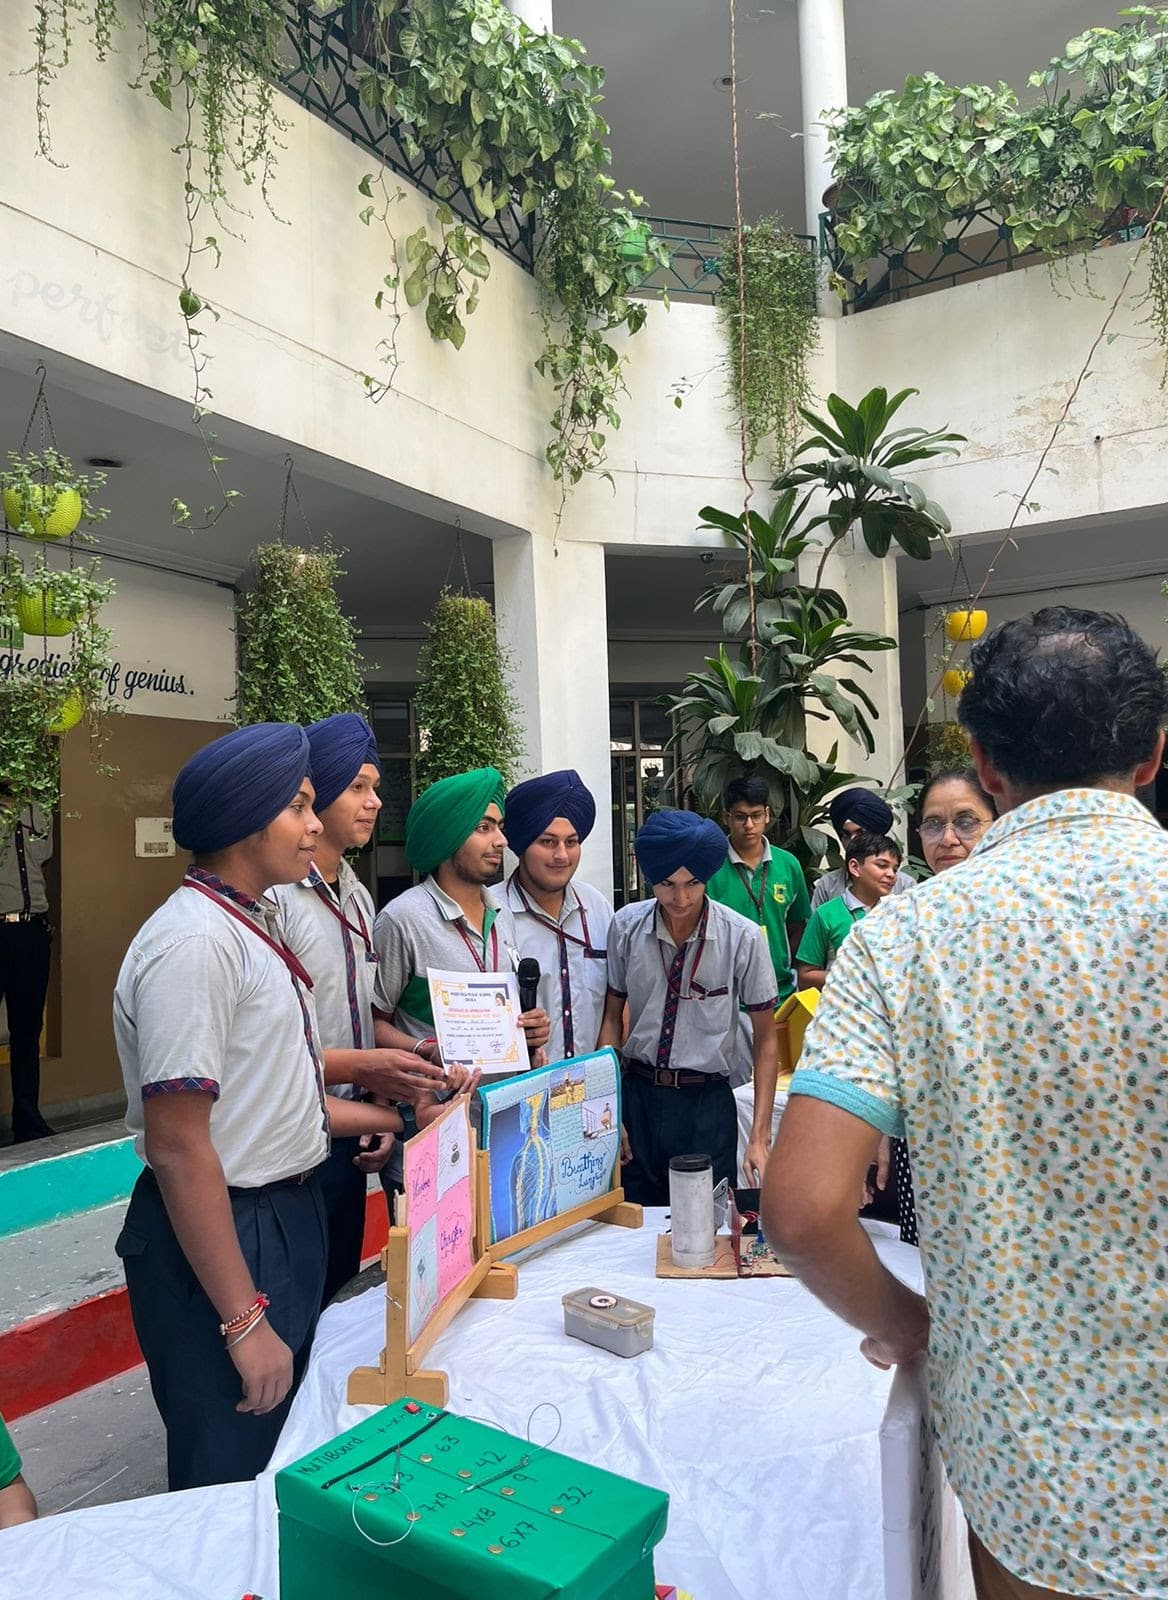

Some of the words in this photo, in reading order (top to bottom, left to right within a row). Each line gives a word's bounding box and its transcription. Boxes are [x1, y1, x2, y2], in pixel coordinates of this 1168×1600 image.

[100, 662, 121, 696] of
[123, 668, 195, 701] genius.
[435, 1435, 461, 1454] 63
[474, 1450, 507, 1469] 42
[557, 1485, 593, 1506] 32
